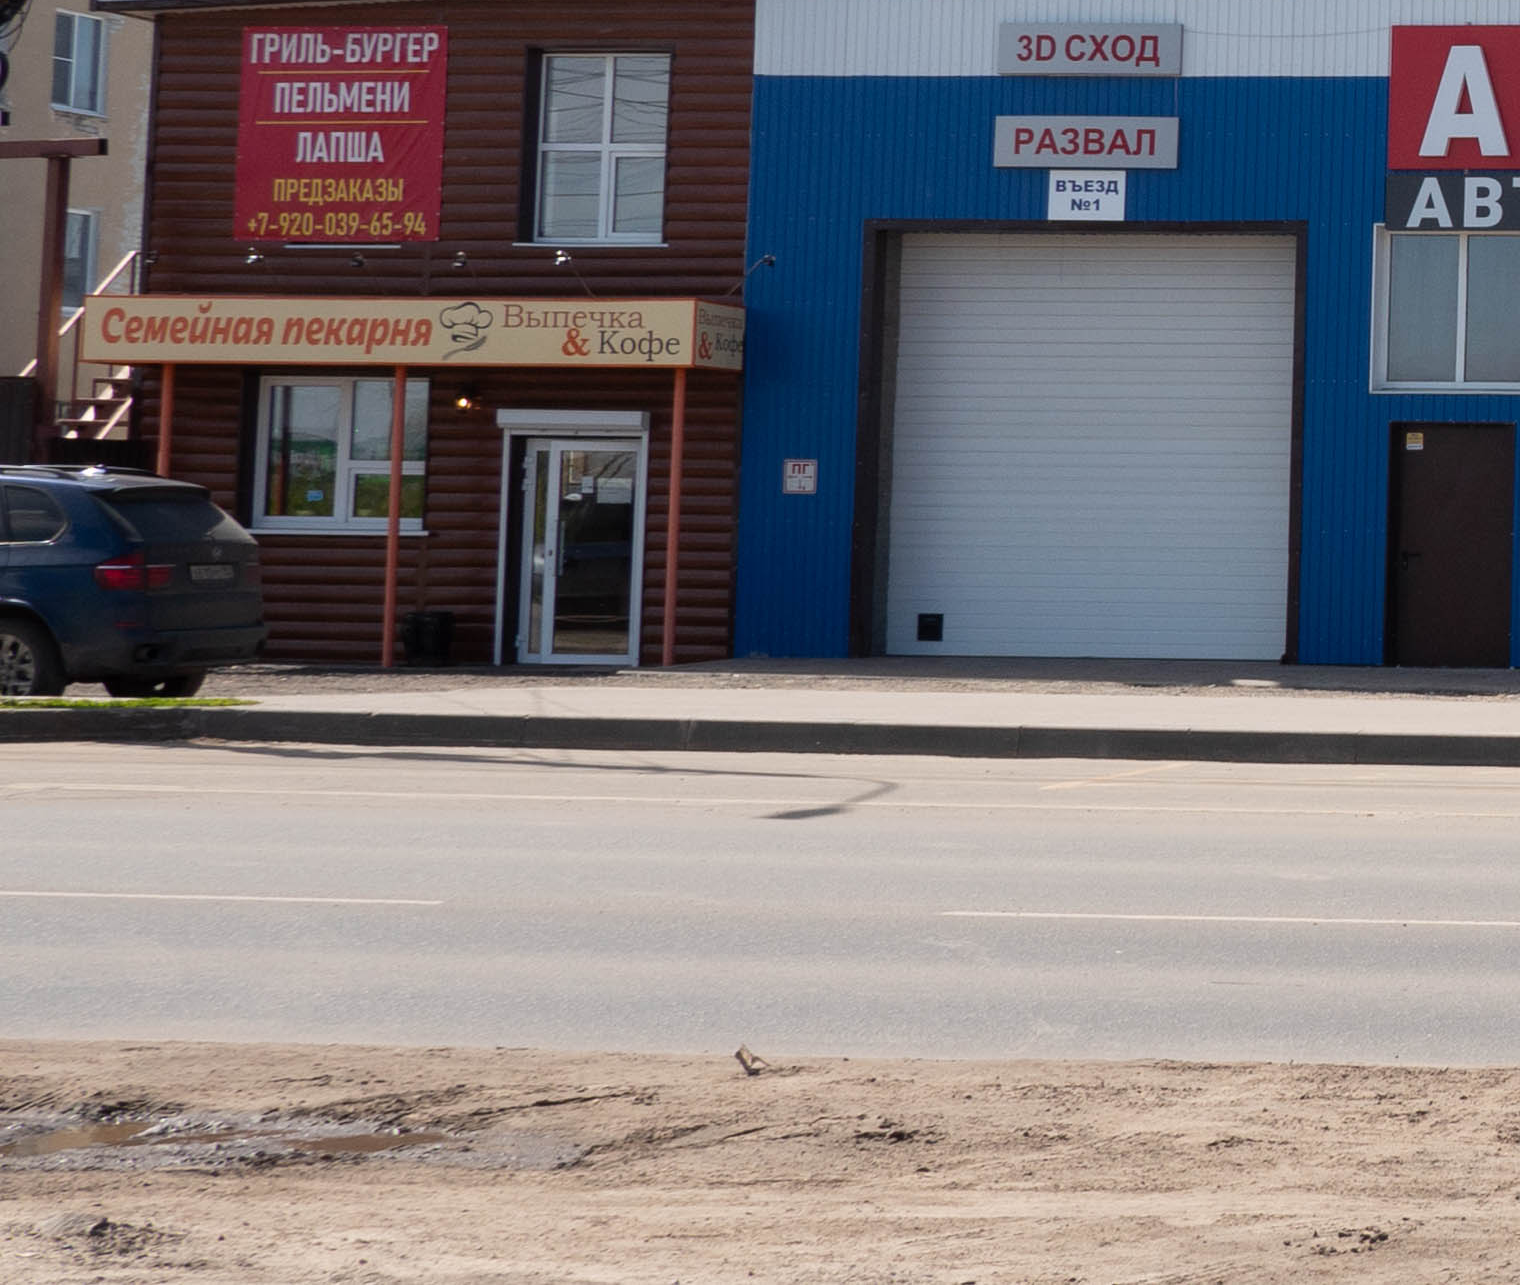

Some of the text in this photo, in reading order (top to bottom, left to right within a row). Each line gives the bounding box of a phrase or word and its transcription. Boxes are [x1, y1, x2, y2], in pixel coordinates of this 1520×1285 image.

[250, 32, 440, 64] ГРИЛЬ-БУРГЕР
[1016, 34, 1160, 67] 3D СХОД
[273, 82, 411, 113] ПЕЛЬМЕНИ
[296, 131, 385, 163] ЛАПША
[1013, 127, 1156, 156] РАЗВАЛ
[272, 178, 404, 206] ПРЕДЗАКАЗЫ
[1055, 180, 1119, 195] ВЪЕЗД
[1070, 199, 1101, 211] №1
[247, 212, 427, 236] +7-920-039-65-94
[101, 302, 433, 355] Семейная пекарня
[503, 304, 646, 329] Выпечка
[561, 328, 681, 362] & Кофе
